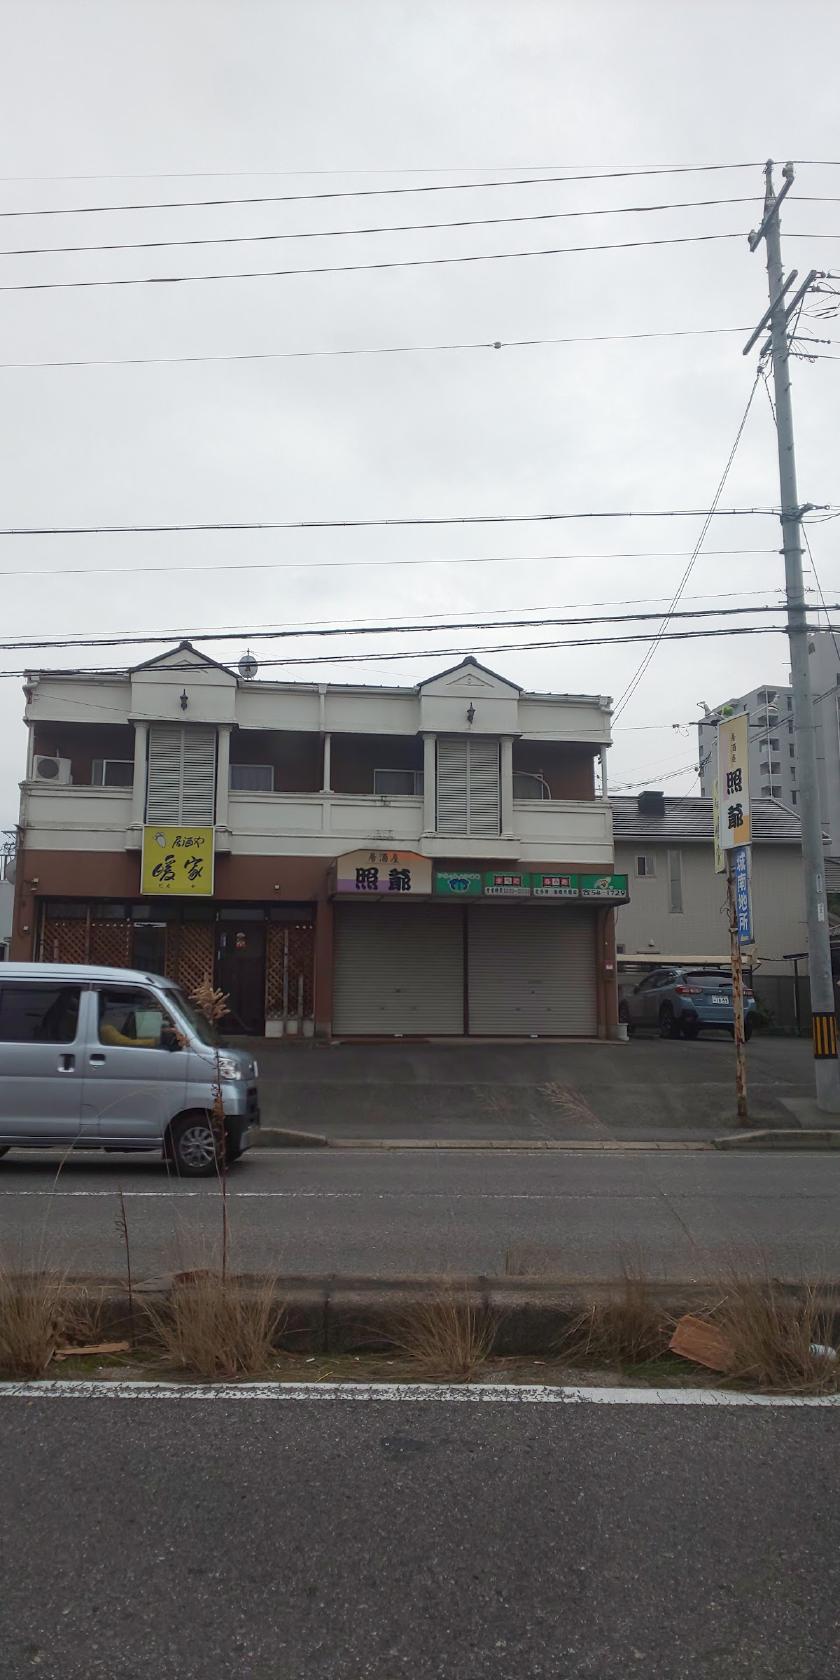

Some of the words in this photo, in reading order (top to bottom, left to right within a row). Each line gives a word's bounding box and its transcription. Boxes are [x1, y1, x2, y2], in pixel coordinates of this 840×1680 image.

[726, 768, 743, 830] 照爺
[355, 867, 412, 891] 照爺
[736, 851, 749, 931] 城南地所
